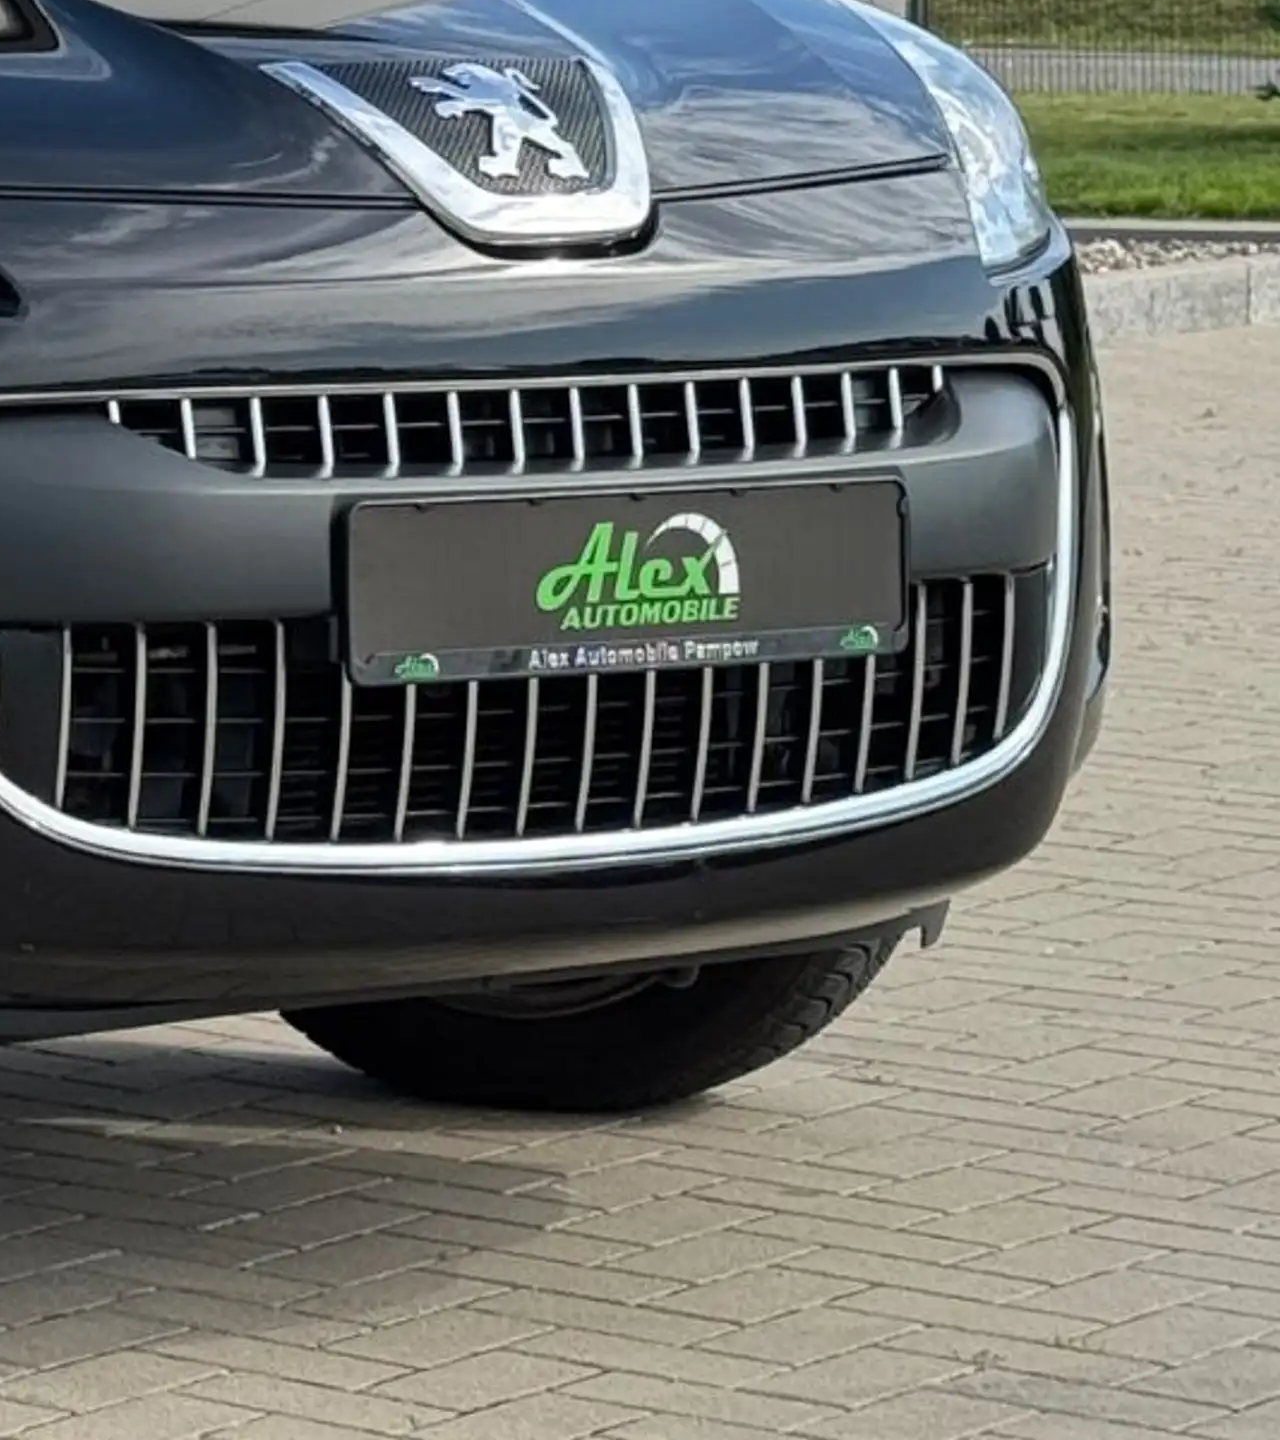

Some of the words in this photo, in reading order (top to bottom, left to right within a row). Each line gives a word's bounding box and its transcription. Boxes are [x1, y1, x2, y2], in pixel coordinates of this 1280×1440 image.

[536, 521, 712, 611] Alex
[561, 597, 740, 630] AUTOMOBILE
[528, 648, 570, 669] Alex
[573, 641, 679, 667] Automobile
